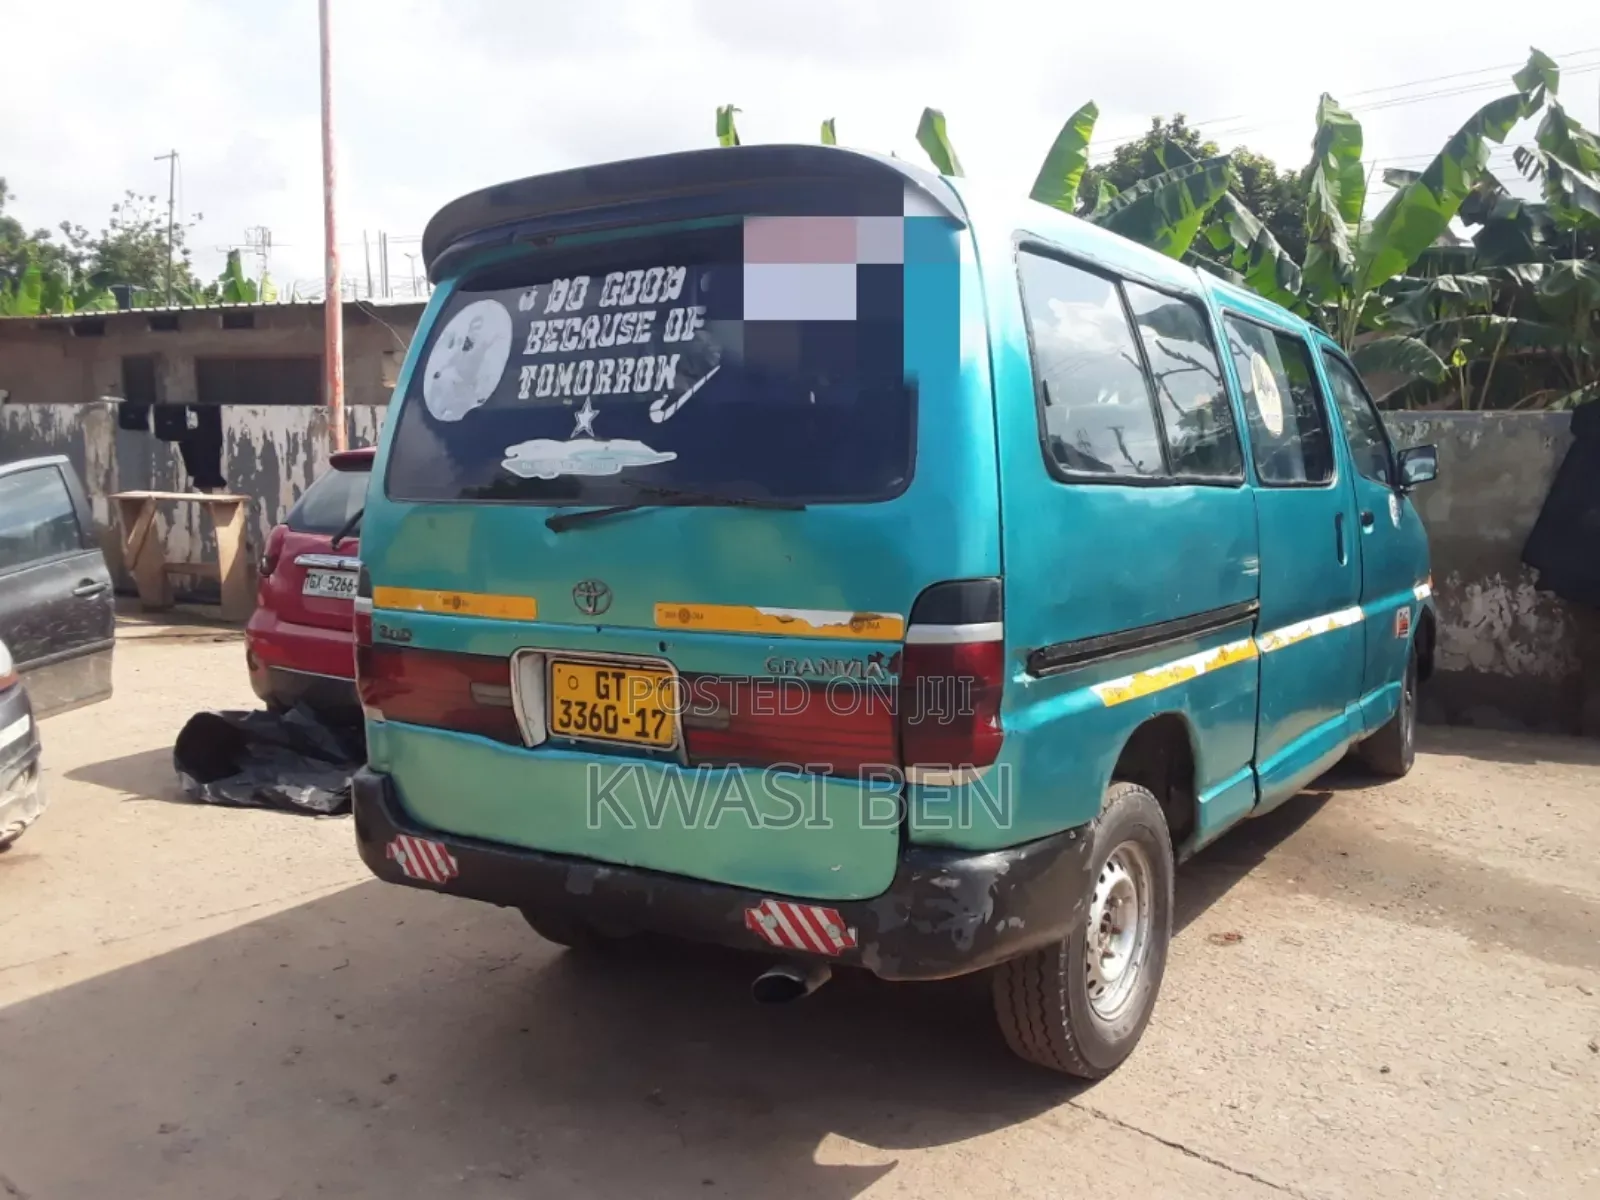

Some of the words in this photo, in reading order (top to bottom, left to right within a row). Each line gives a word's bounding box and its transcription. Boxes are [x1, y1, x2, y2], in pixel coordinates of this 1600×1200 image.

[544, 275, 590, 315] DO
[522, 310, 656, 355] BECAUSE
[663, 305, 707, 343] OF
[518, 353, 681, 400] TOMORROW
[595, 671, 626, 701] GT
[764, 654, 885, 681] GRANVIA
